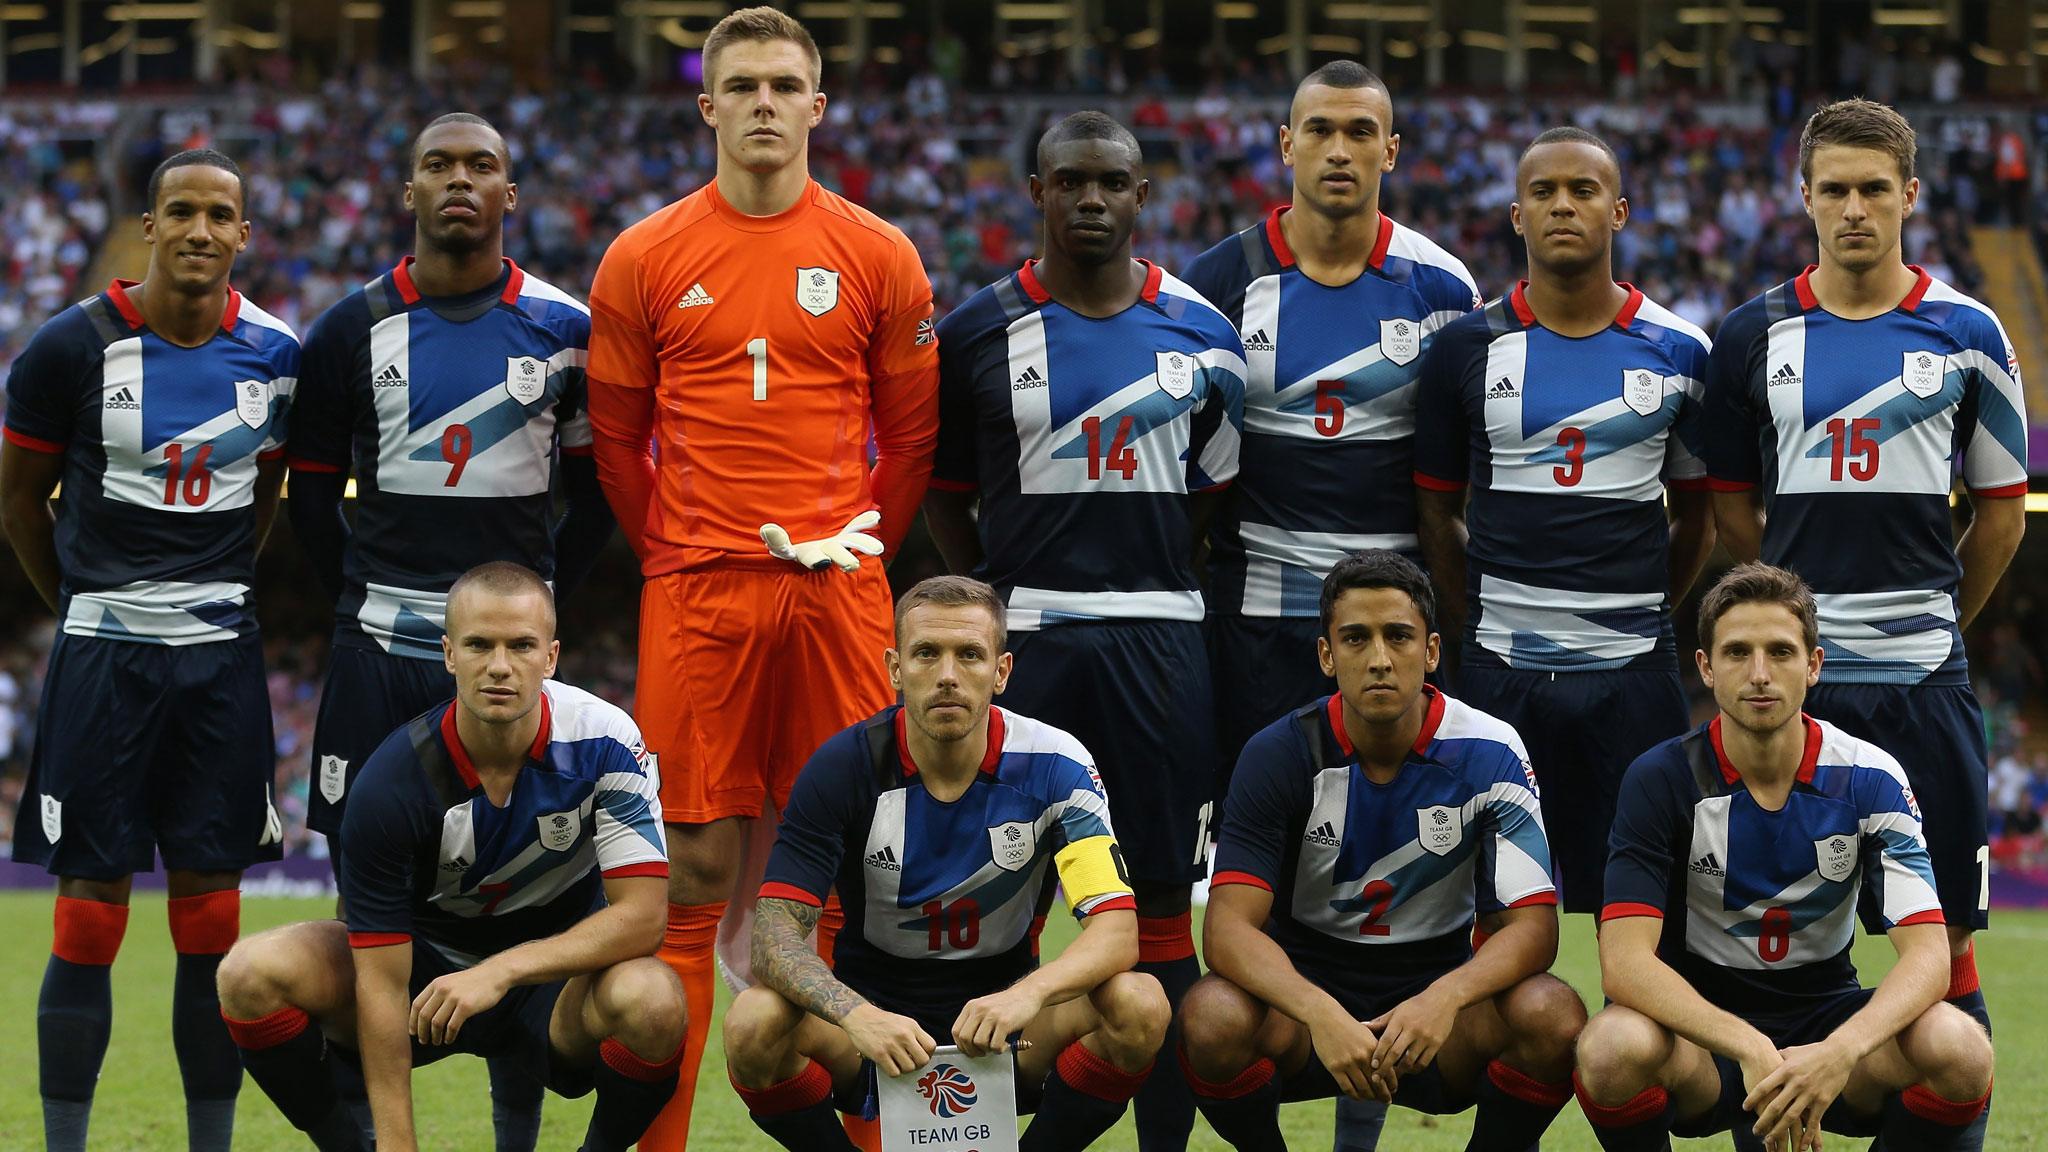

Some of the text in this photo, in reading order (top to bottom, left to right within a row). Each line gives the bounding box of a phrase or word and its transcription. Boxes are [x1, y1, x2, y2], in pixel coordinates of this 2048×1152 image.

[678, 295, 714, 309] adidas
[374, 379, 408, 388] adidas
[746, 338, 767, 401] 1
[1012, 379, 1048, 391] adidas
[1768, 376, 1802, 387] adidas
[105, 401, 140, 410] adidas
[1314, 380, 1345, 437] 5
[1487, 390, 1520, 400] adidas
[441, 424, 473, 487] 9
[1081, 416, 1137, 480] 14
[1552, 427, 1586, 487] 3
[1826, 418, 1881, 482] 15
[163, 443, 214, 507] 16
[1304, 834, 1341, 847] adidas
[864, 857, 901, 872] adidas
[1688, 864, 1725, 878] adidas
[478, 881, 513, 914] 7
[1359, 879, 1393, 936] 2
[922, 897, 980, 951] 10
[1757, 906, 1792, 963] 8
[908, 1124, 990, 1145] TEAM GB
